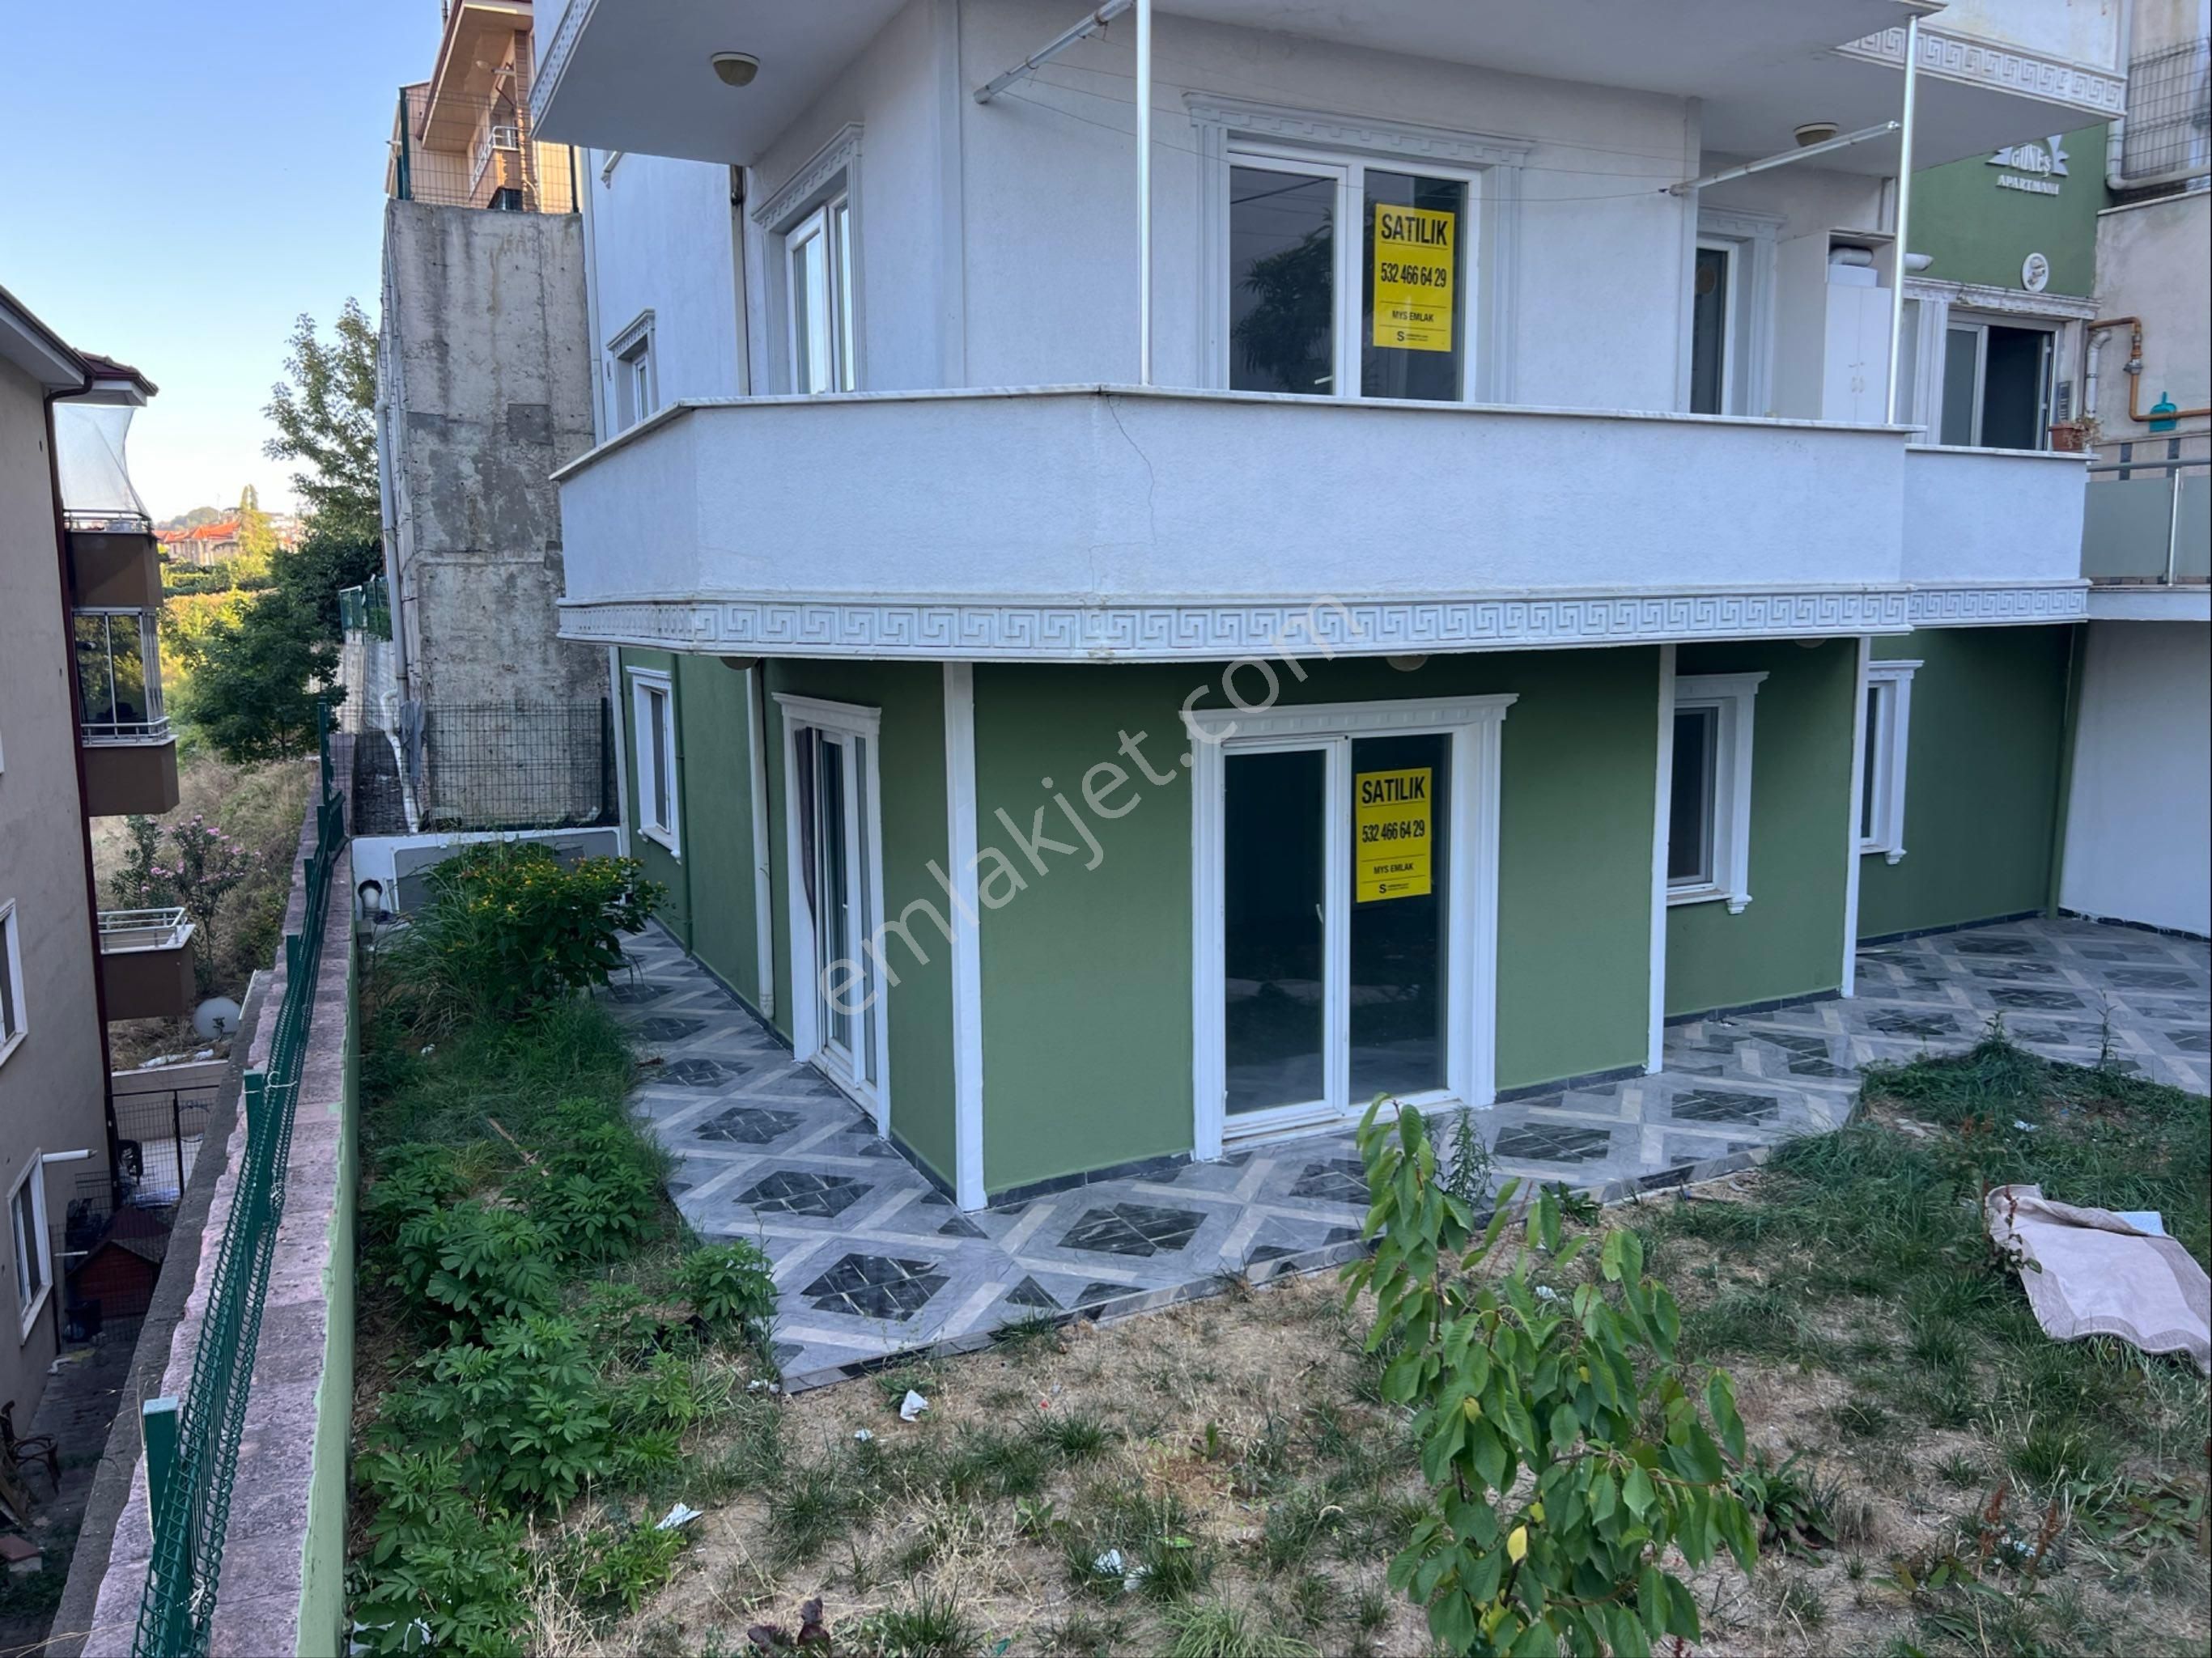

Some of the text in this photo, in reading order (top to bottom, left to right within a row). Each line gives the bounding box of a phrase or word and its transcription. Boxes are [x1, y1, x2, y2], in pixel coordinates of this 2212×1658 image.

[1381, 213, 1448, 246] SATILIK
[1381, 262, 1447, 288] 532 466 64 29
[1392, 310, 1434, 322] MYS EMLAK
[1397, 330, 1404, 341] S
[1361, 776, 1425, 804] SATILIK
[1362, 819, 1425, 843] 532 466 64 29
[1373, 863, 1414, 875] MYS EMLAK
[1378, 884, 1386, 894] S
